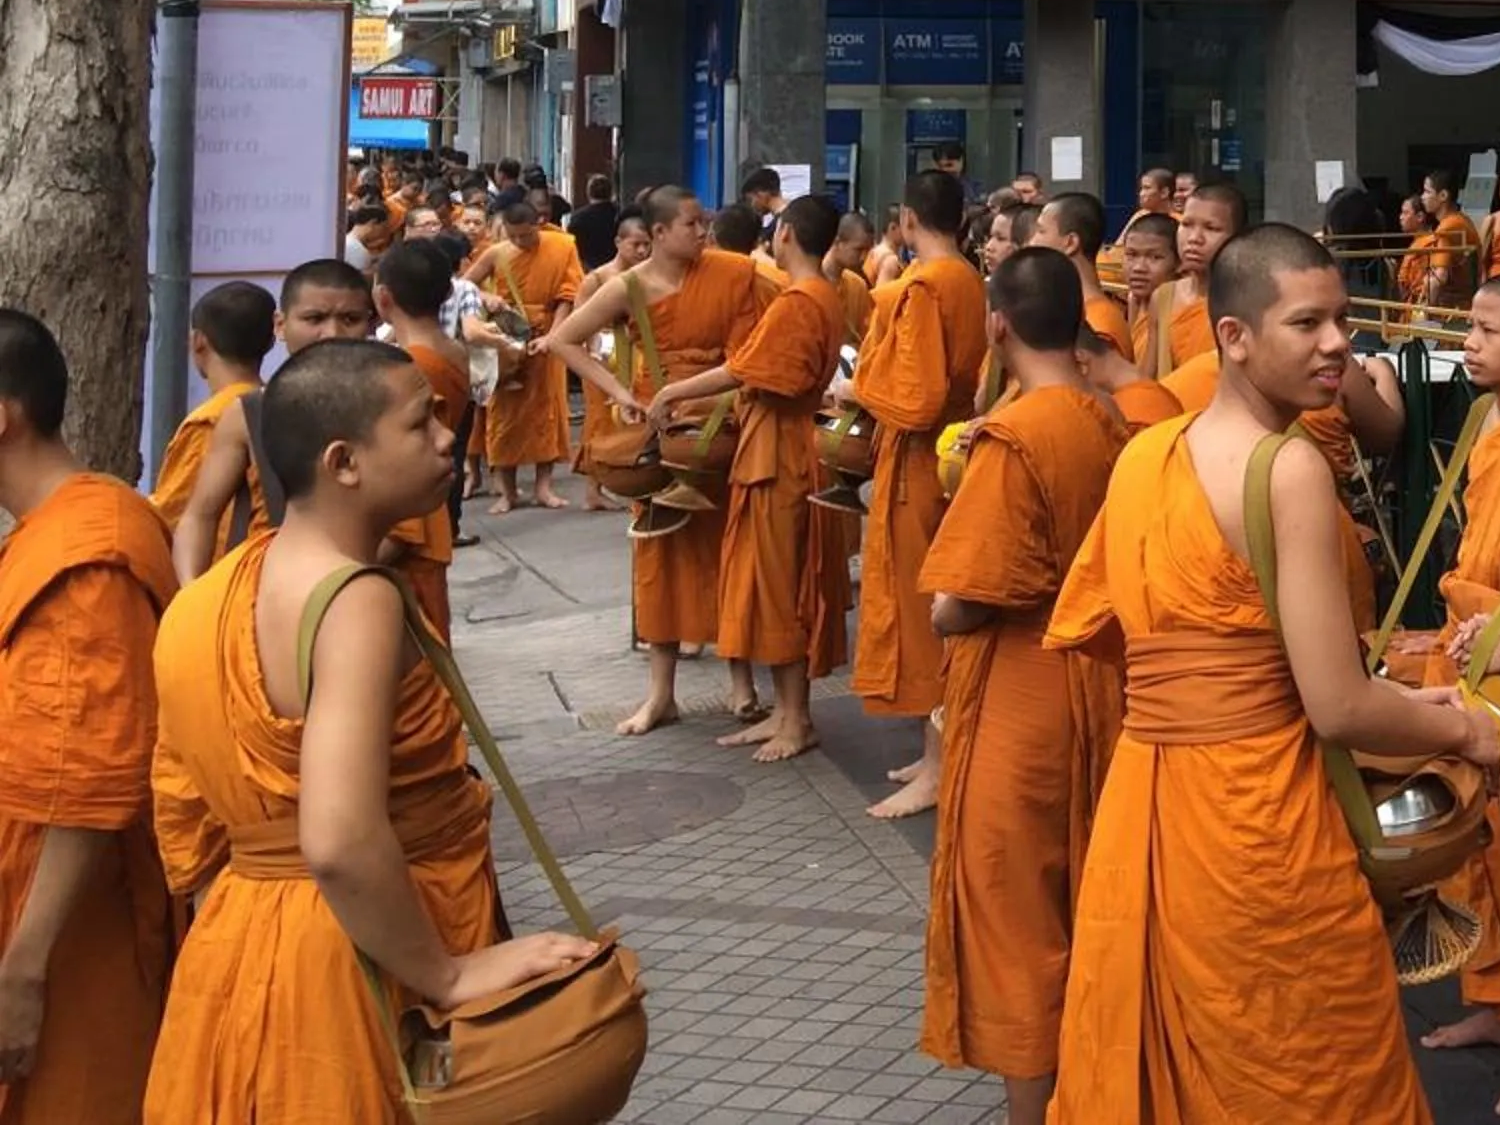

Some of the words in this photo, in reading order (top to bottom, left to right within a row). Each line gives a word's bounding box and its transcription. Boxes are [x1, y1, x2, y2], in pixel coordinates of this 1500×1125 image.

[893, 33, 931, 50] ATM
[362, 87, 405, 116] SAMUI
[409, 87, 434, 116] ART
